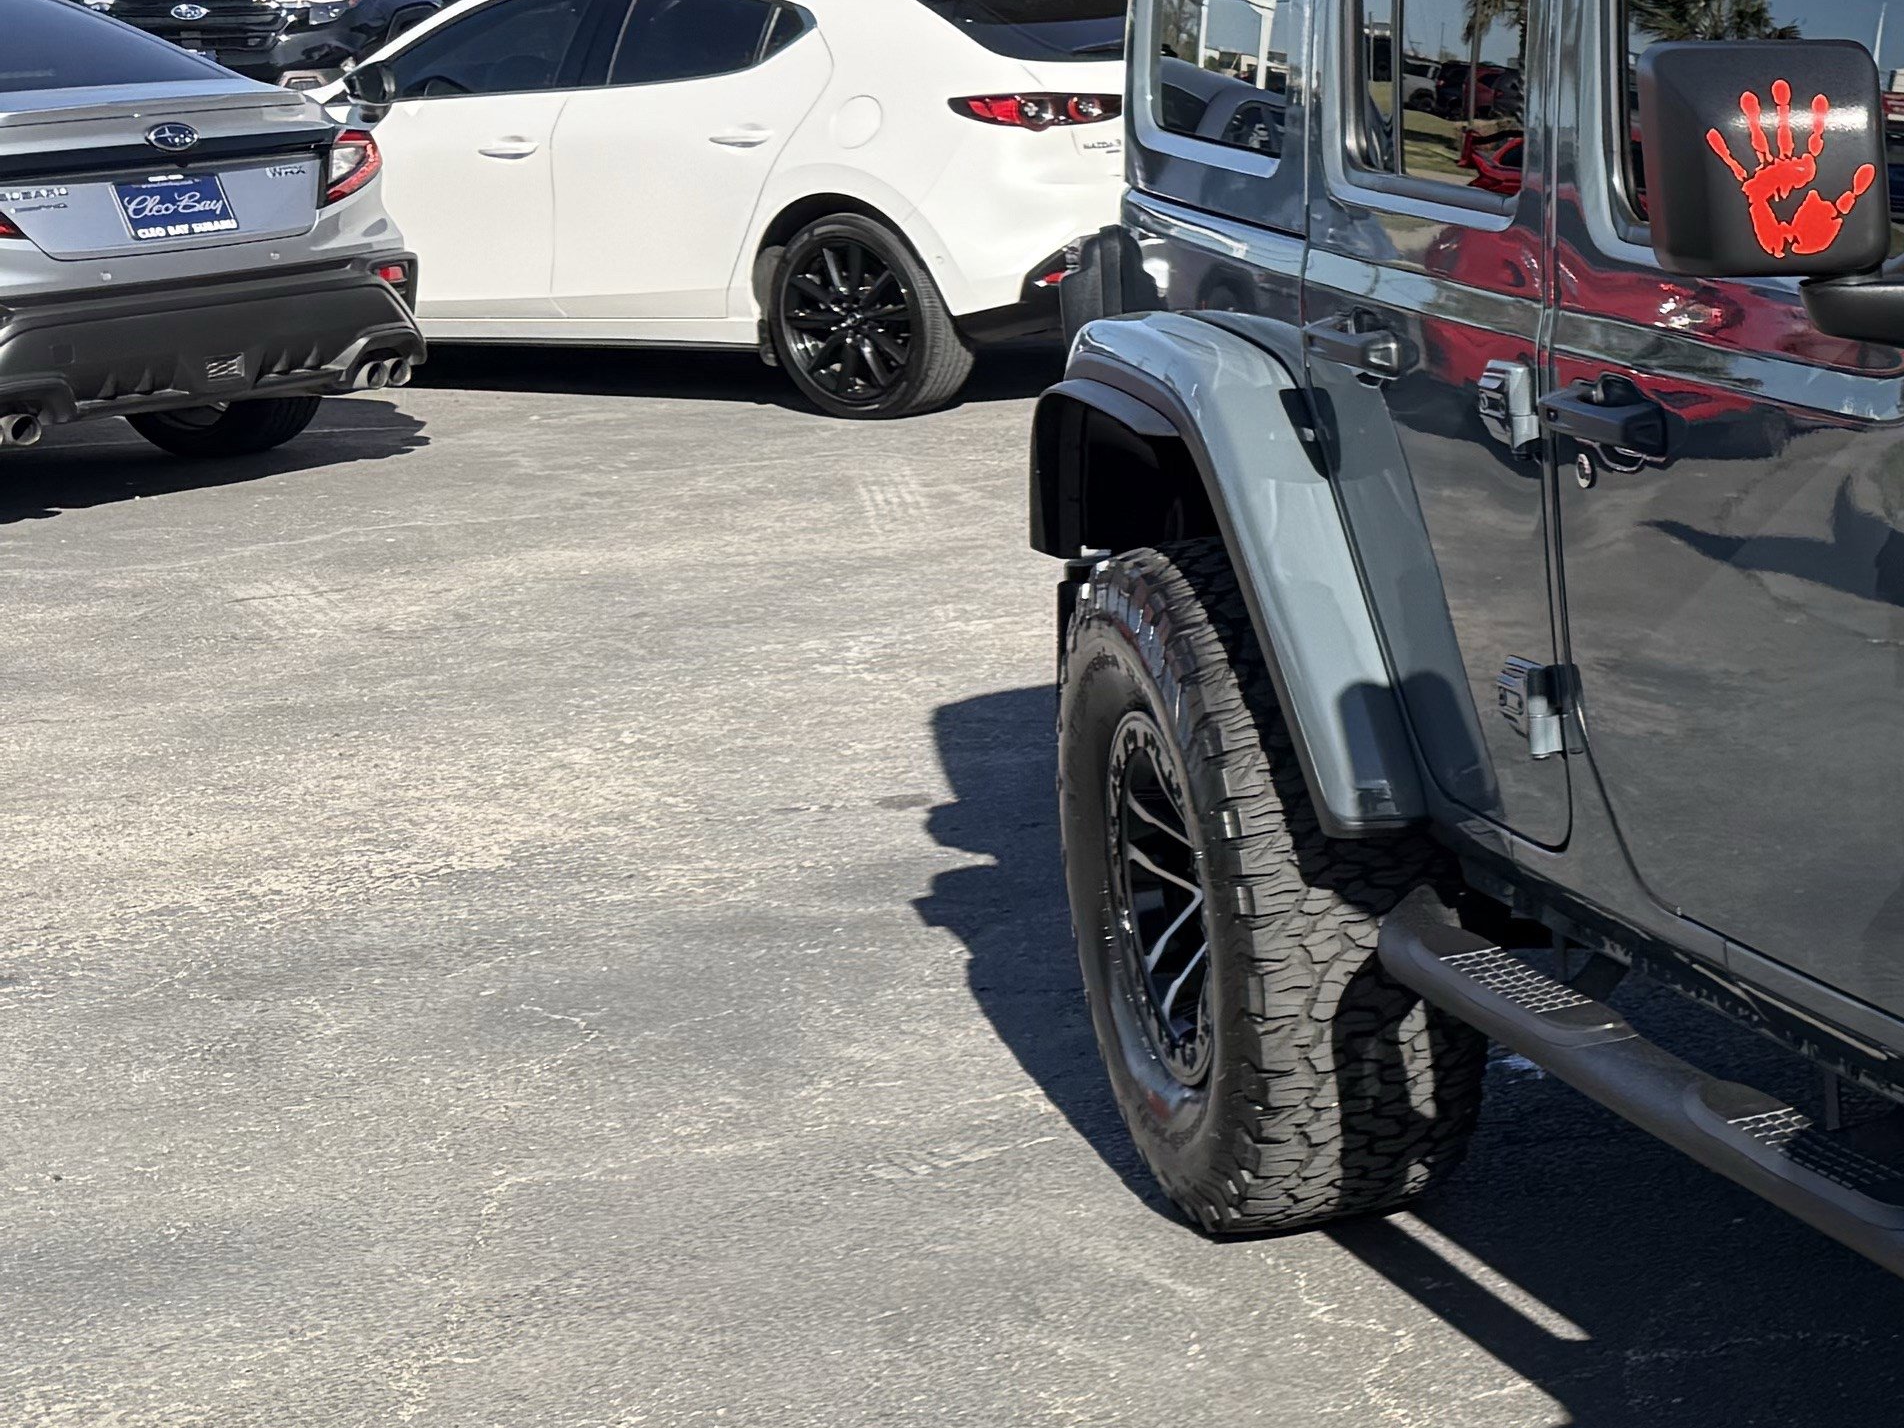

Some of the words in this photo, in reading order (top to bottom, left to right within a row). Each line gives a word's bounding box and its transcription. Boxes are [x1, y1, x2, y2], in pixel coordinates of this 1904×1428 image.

[124, 195, 177, 219] Cleo
[174, 192, 223, 215] Bay
[136, 226, 166, 239] CLEO
[167, 224, 189, 236] BAY
